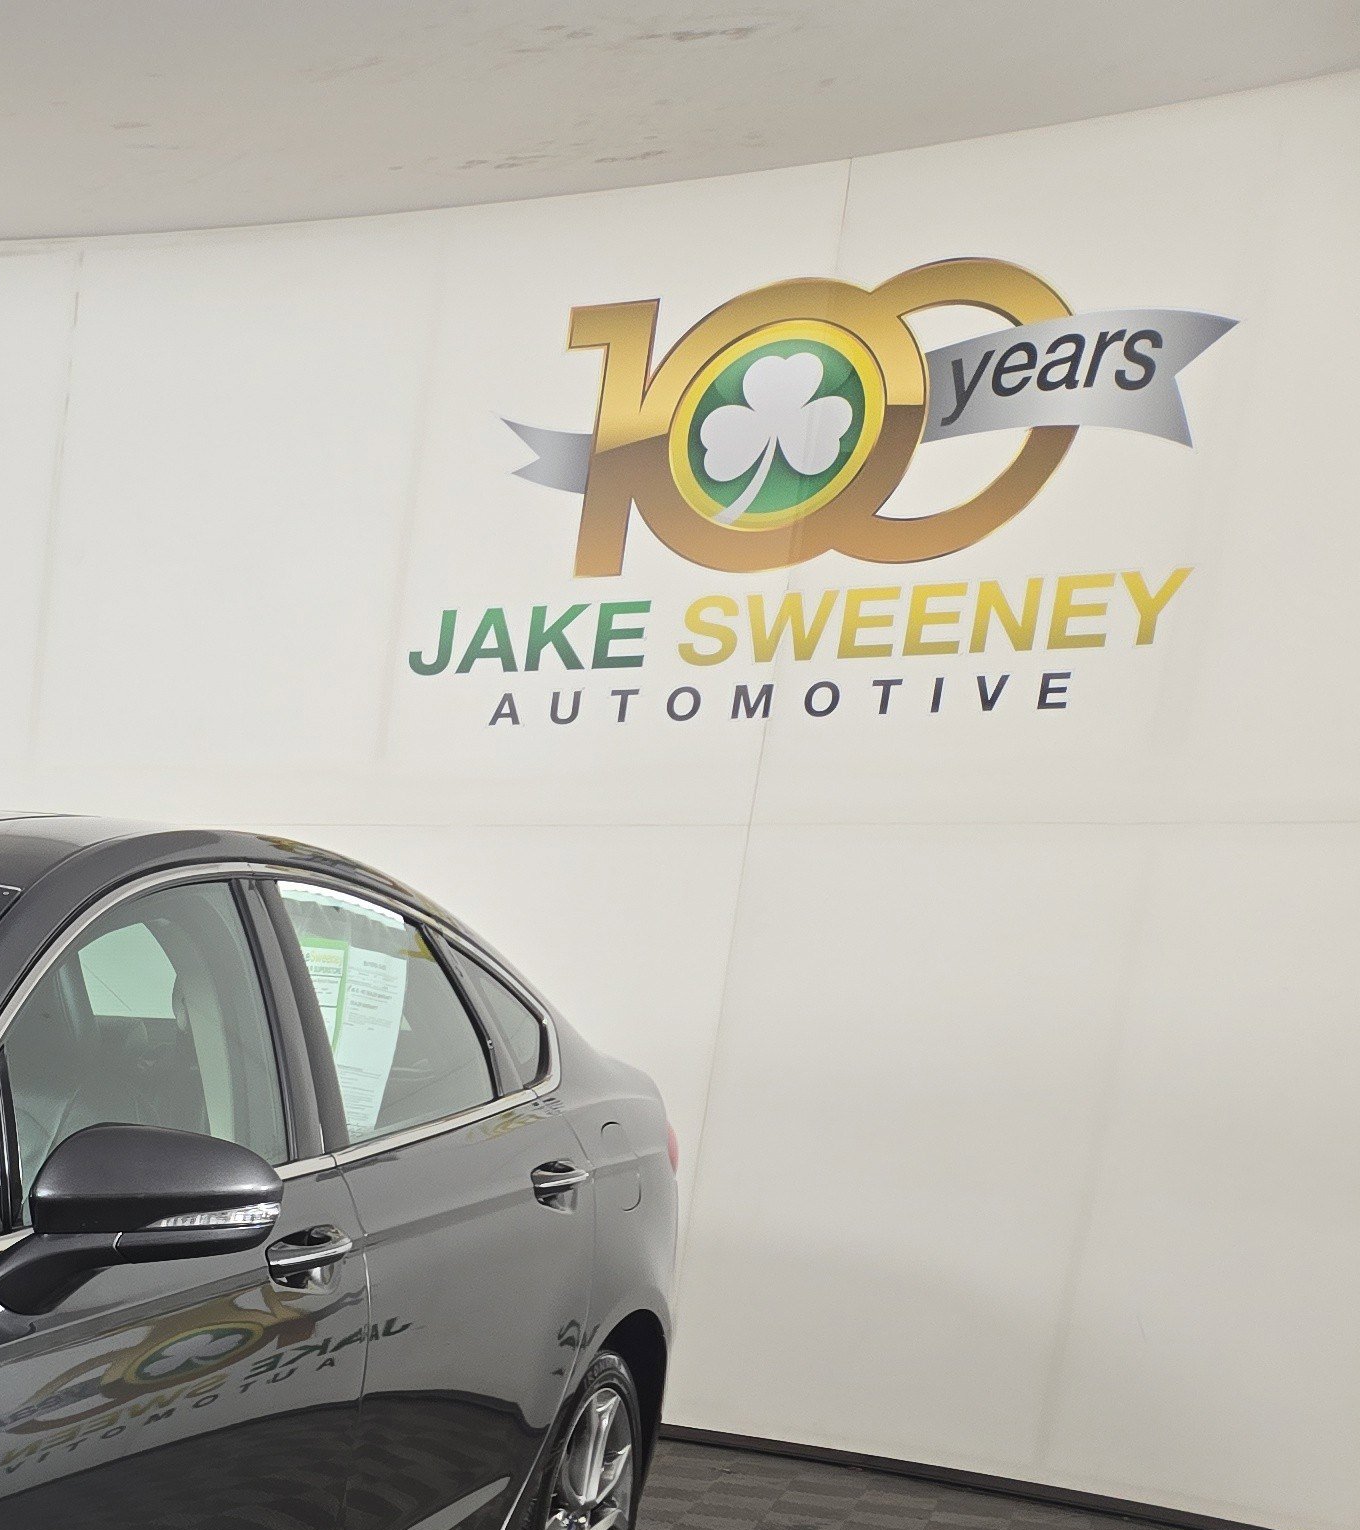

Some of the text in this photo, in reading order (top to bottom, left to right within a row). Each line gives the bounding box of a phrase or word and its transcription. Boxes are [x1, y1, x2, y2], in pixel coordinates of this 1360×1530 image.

[567, 257, 1163, 578] 100 years
[408, 567, 1194, 676] JAKE SWEENEY
[488, 671, 1073, 726] AUTOMOTIVE
